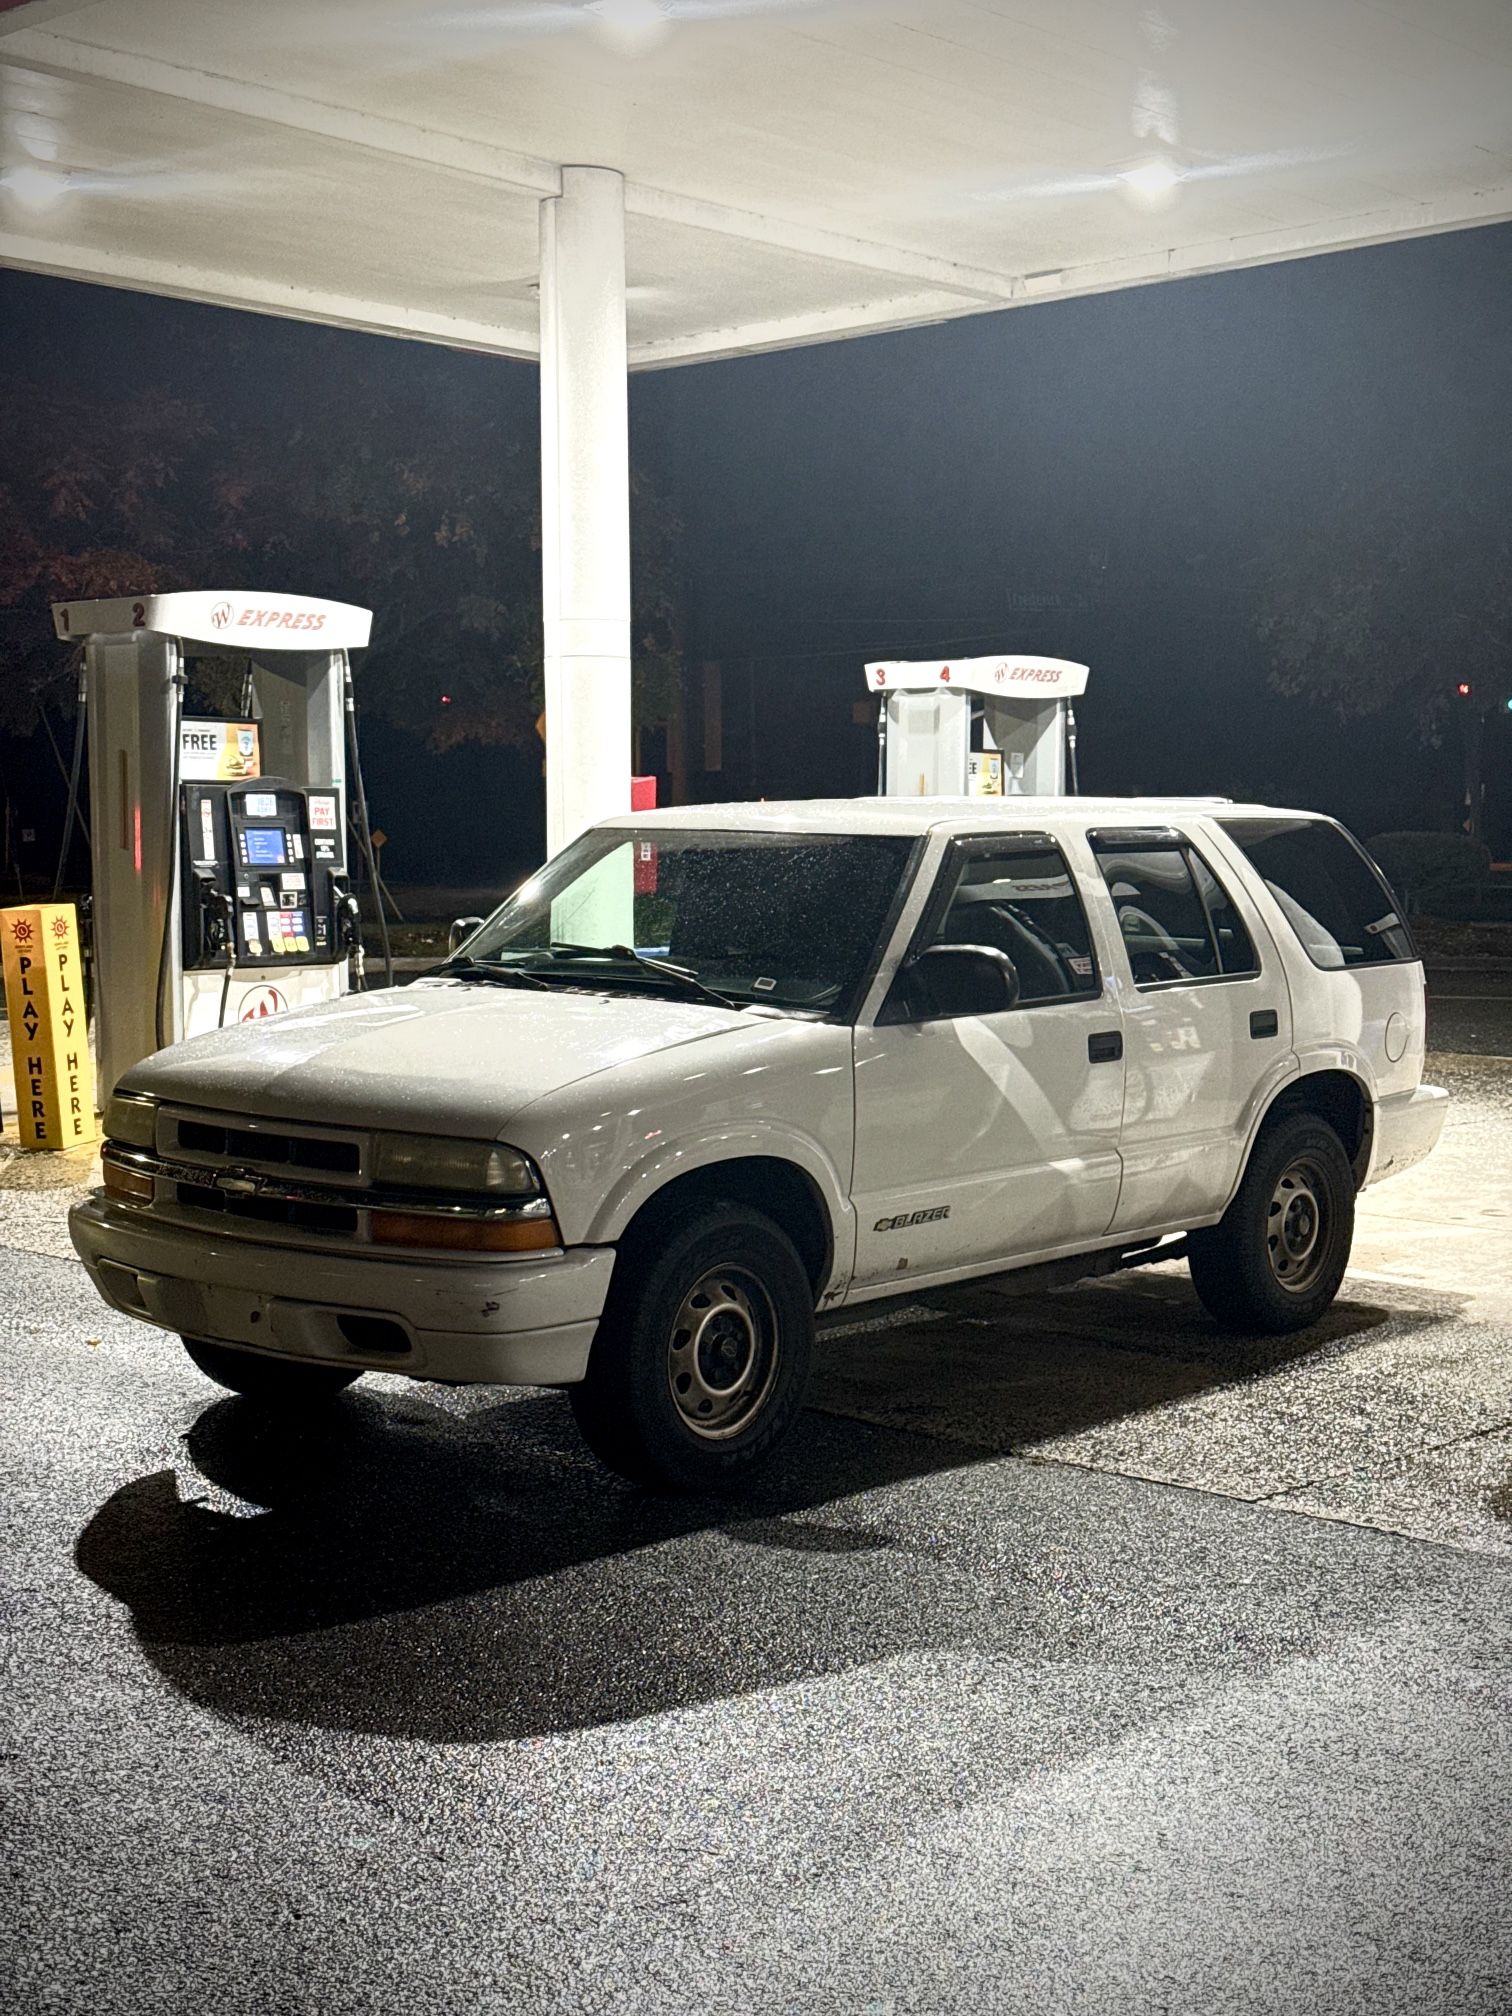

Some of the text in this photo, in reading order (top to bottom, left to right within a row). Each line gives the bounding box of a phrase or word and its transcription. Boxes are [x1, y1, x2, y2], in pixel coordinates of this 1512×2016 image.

[60, 608, 70, 632] 1
[132, 603, 147, 628] 2
[236, 609, 328, 631] EXPRESS
[876, 668, 886, 686] 3
[939, 666, 951, 683] 4
[1008, 667, 1063, 684] EXPRESS
[182, 733, 218, 751] FREE
[312, 818, 334, 827] FIRST
[314, 807, 331, 817] PAY
[19, 956, 39, 1041] PLAY
[59, 953, 75, 1038] PLAY
[27, 1057, 47, 1140] HERE
[66, 1051, 83, 1136] HERE
